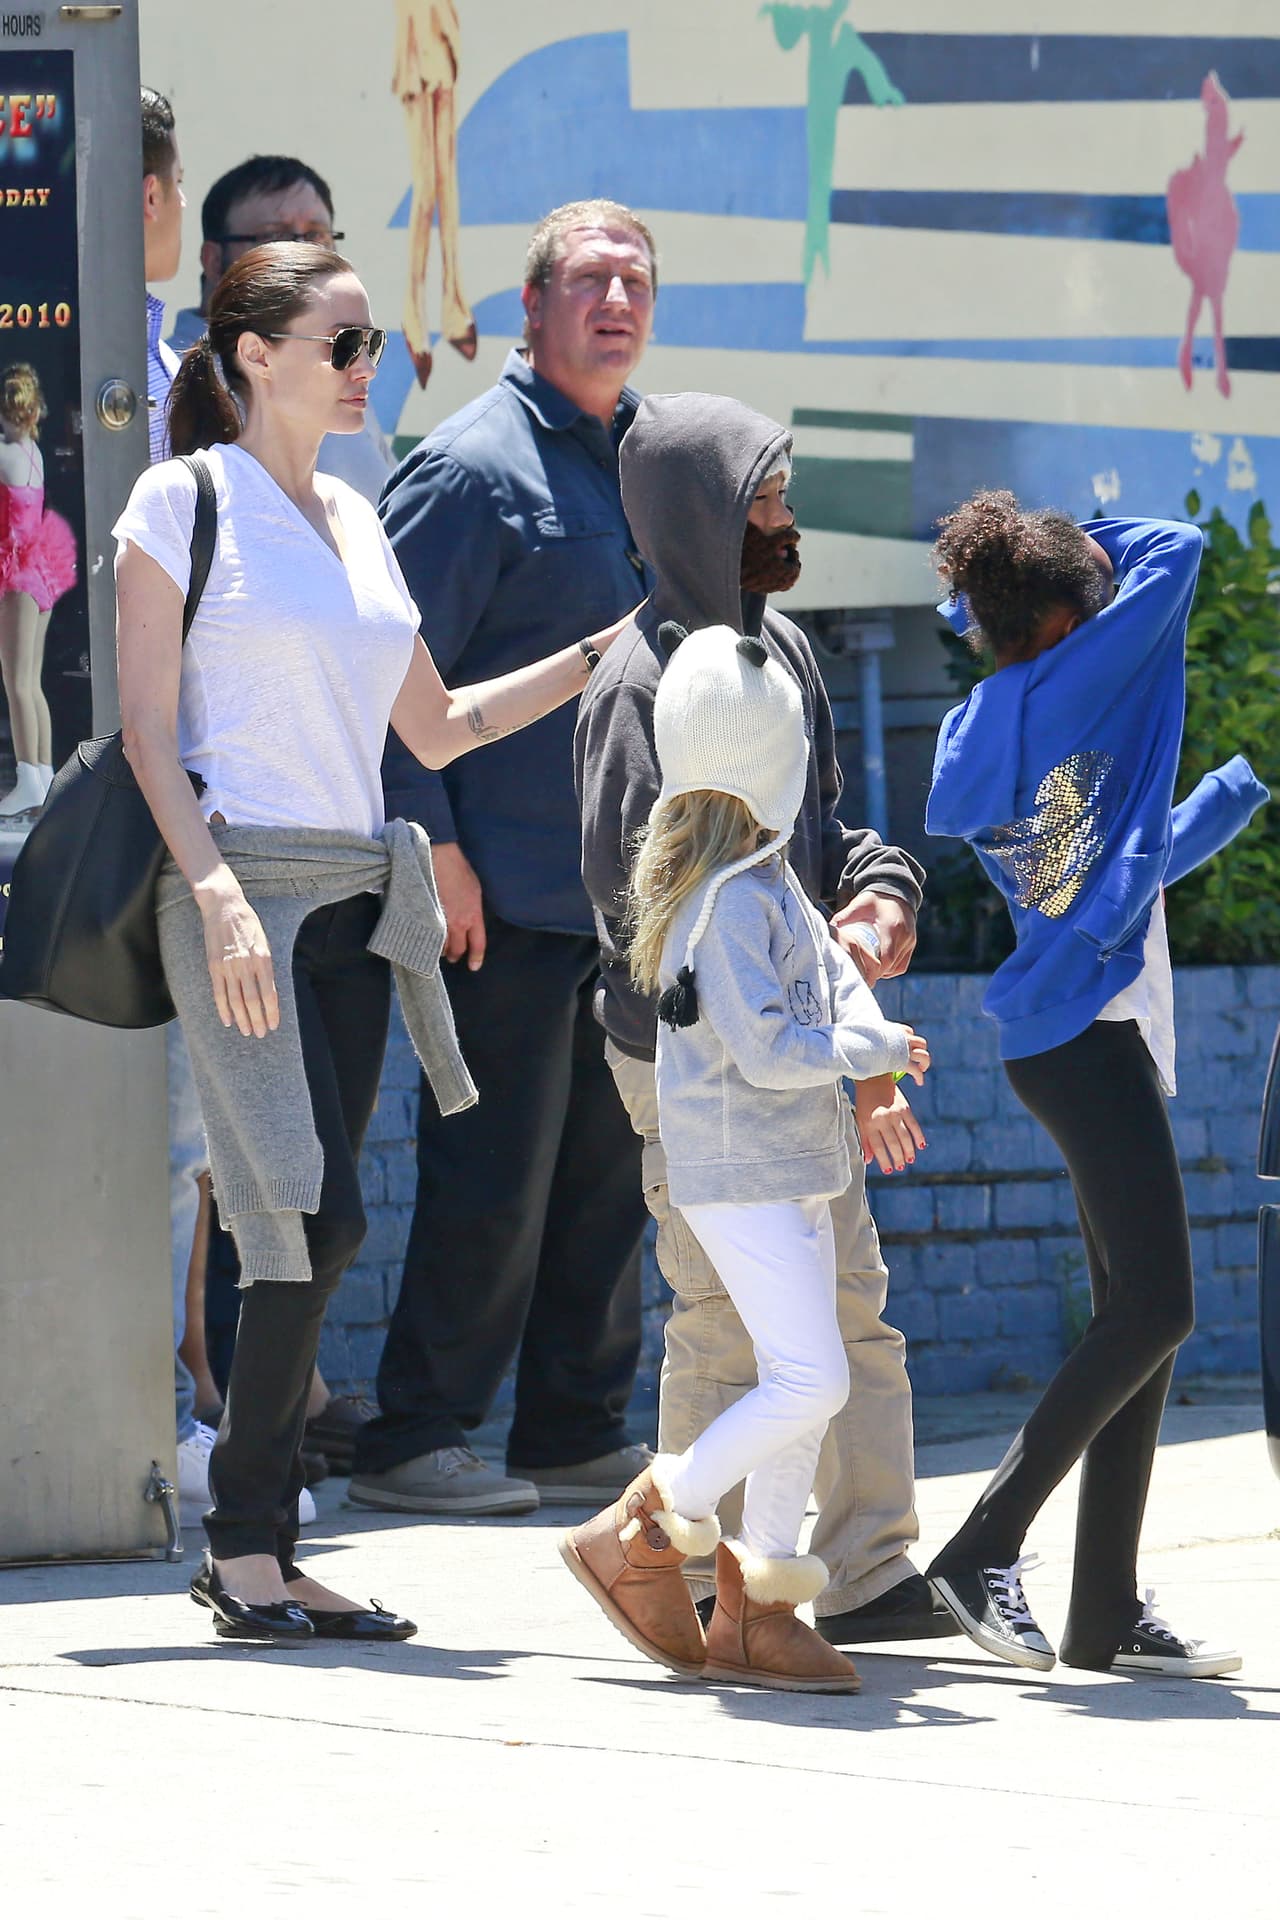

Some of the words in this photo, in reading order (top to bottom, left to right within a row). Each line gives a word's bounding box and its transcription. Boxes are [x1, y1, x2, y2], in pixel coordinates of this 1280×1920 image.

[2, 14, 42, 37] HOURS
[0, 94, 56, 138] E”
[0, 188, 51, 207] DAY
[0, 302, 71, 328] 2010
